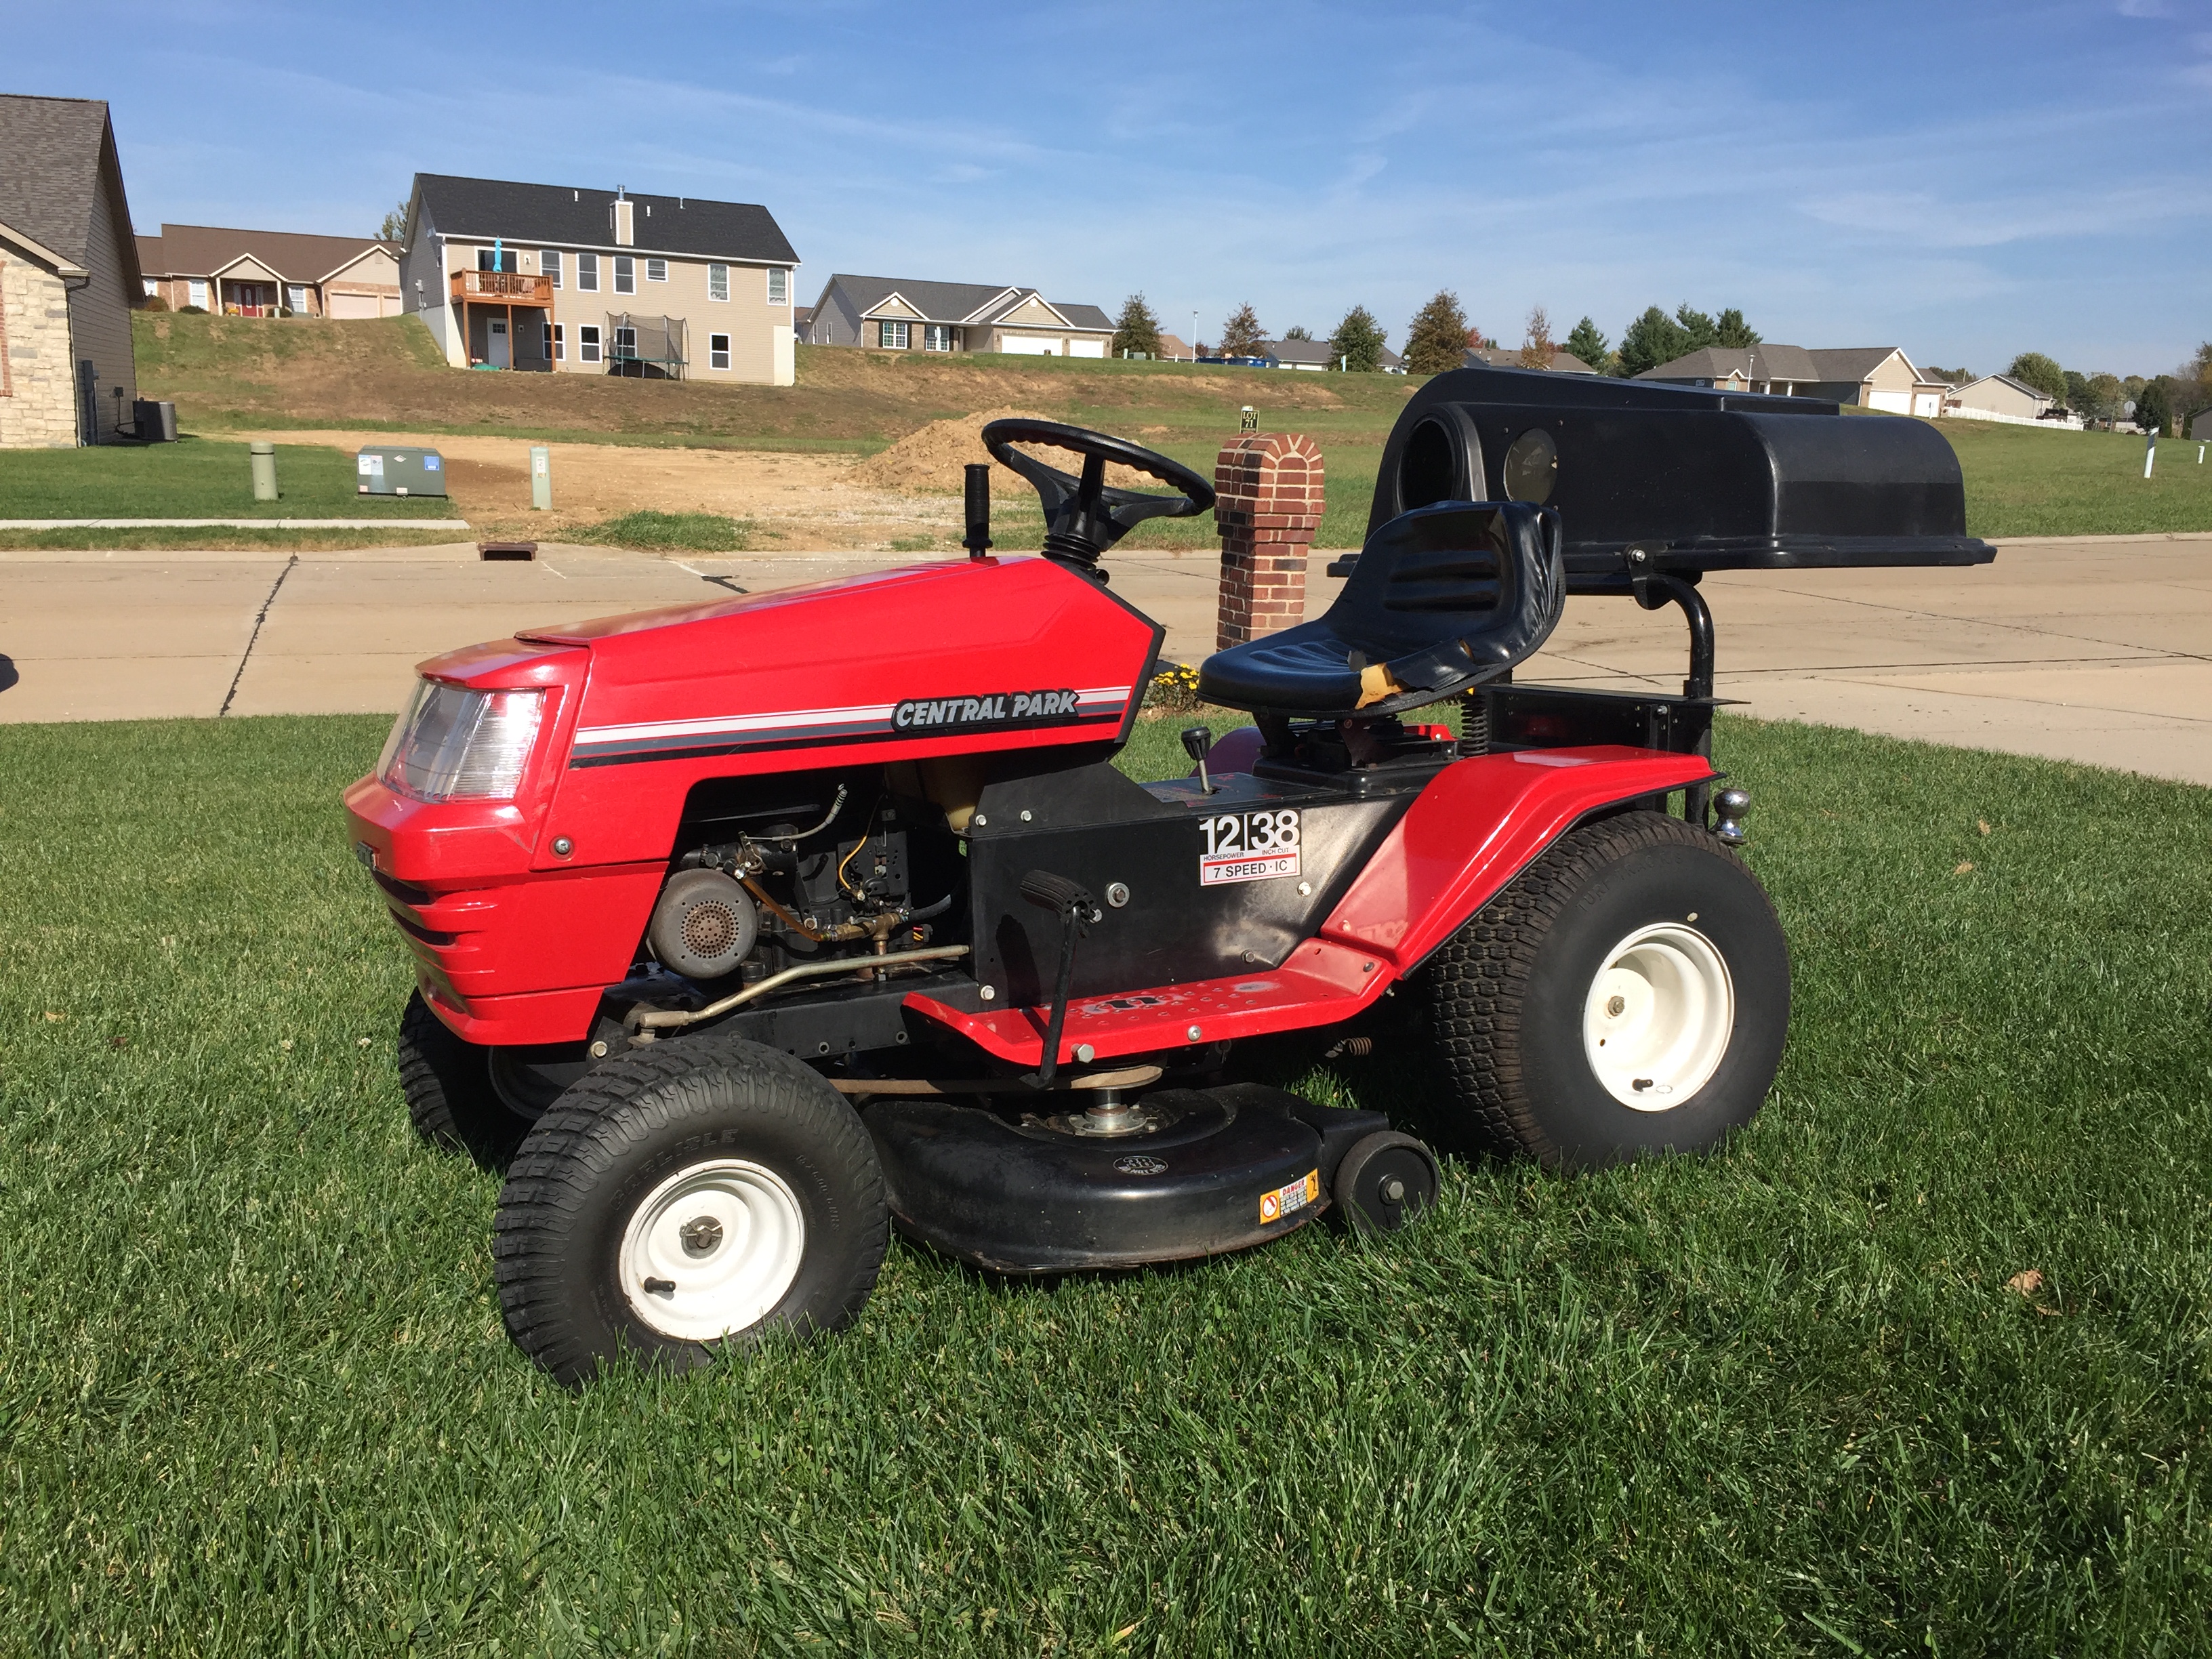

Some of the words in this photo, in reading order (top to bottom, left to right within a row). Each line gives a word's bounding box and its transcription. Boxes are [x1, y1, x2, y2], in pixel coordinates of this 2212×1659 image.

[1243, 411, 1257, 419] LOT
[1245, 419, 1253, 428] 71
[896, 695, 1006, 727] CENTRAL
[1012, 691, 1078, 718] PARK
[1199, 815, 1241, 855] 12
[1251, 810, 1300, 849] 38
[1204, 852, 1244, 861] HORSEPOWER
[1214, 867, 1221, 879] 7
[1225, 863, 1267, 878] SPEED
[1275, 859, 1288, 872] IC
[609, 1128, 739, 1211] CARLISLE
[1282, 1179, 1305, 1196] DANGER
